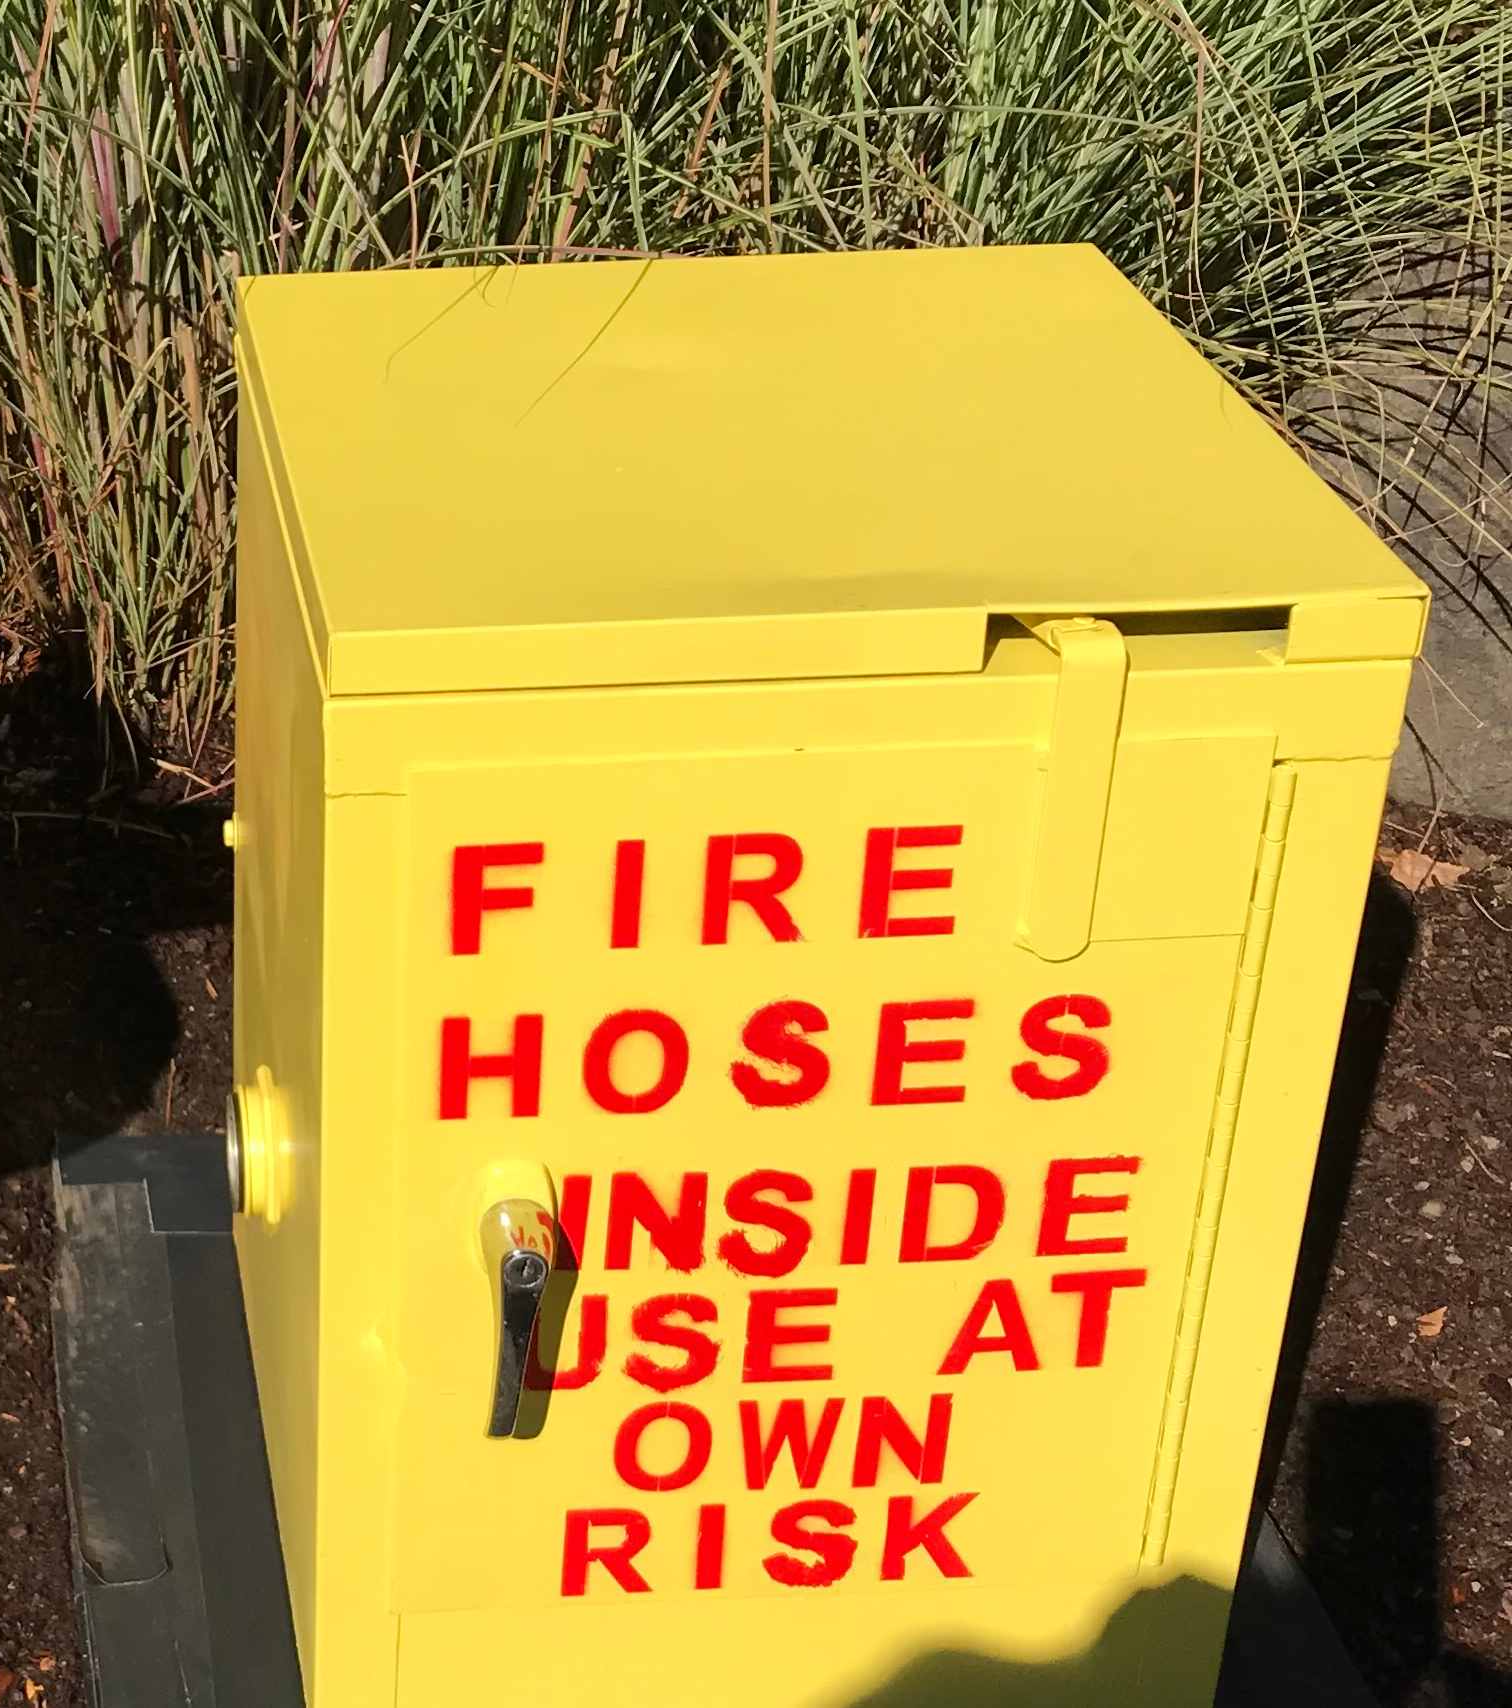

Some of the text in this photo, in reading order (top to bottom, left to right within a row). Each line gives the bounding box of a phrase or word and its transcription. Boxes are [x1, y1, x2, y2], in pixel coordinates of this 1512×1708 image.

[450, 825, 963, 956] FIRE
[439, 995, 1111, 1120] HOSES
[554, 1157, 1142, 1278] INSIDE
[523, 1269, 1147, 1393] USE AT
[614, 1394, 953, 1492] OWN
[561, 1494, 978, 1597] RISK
